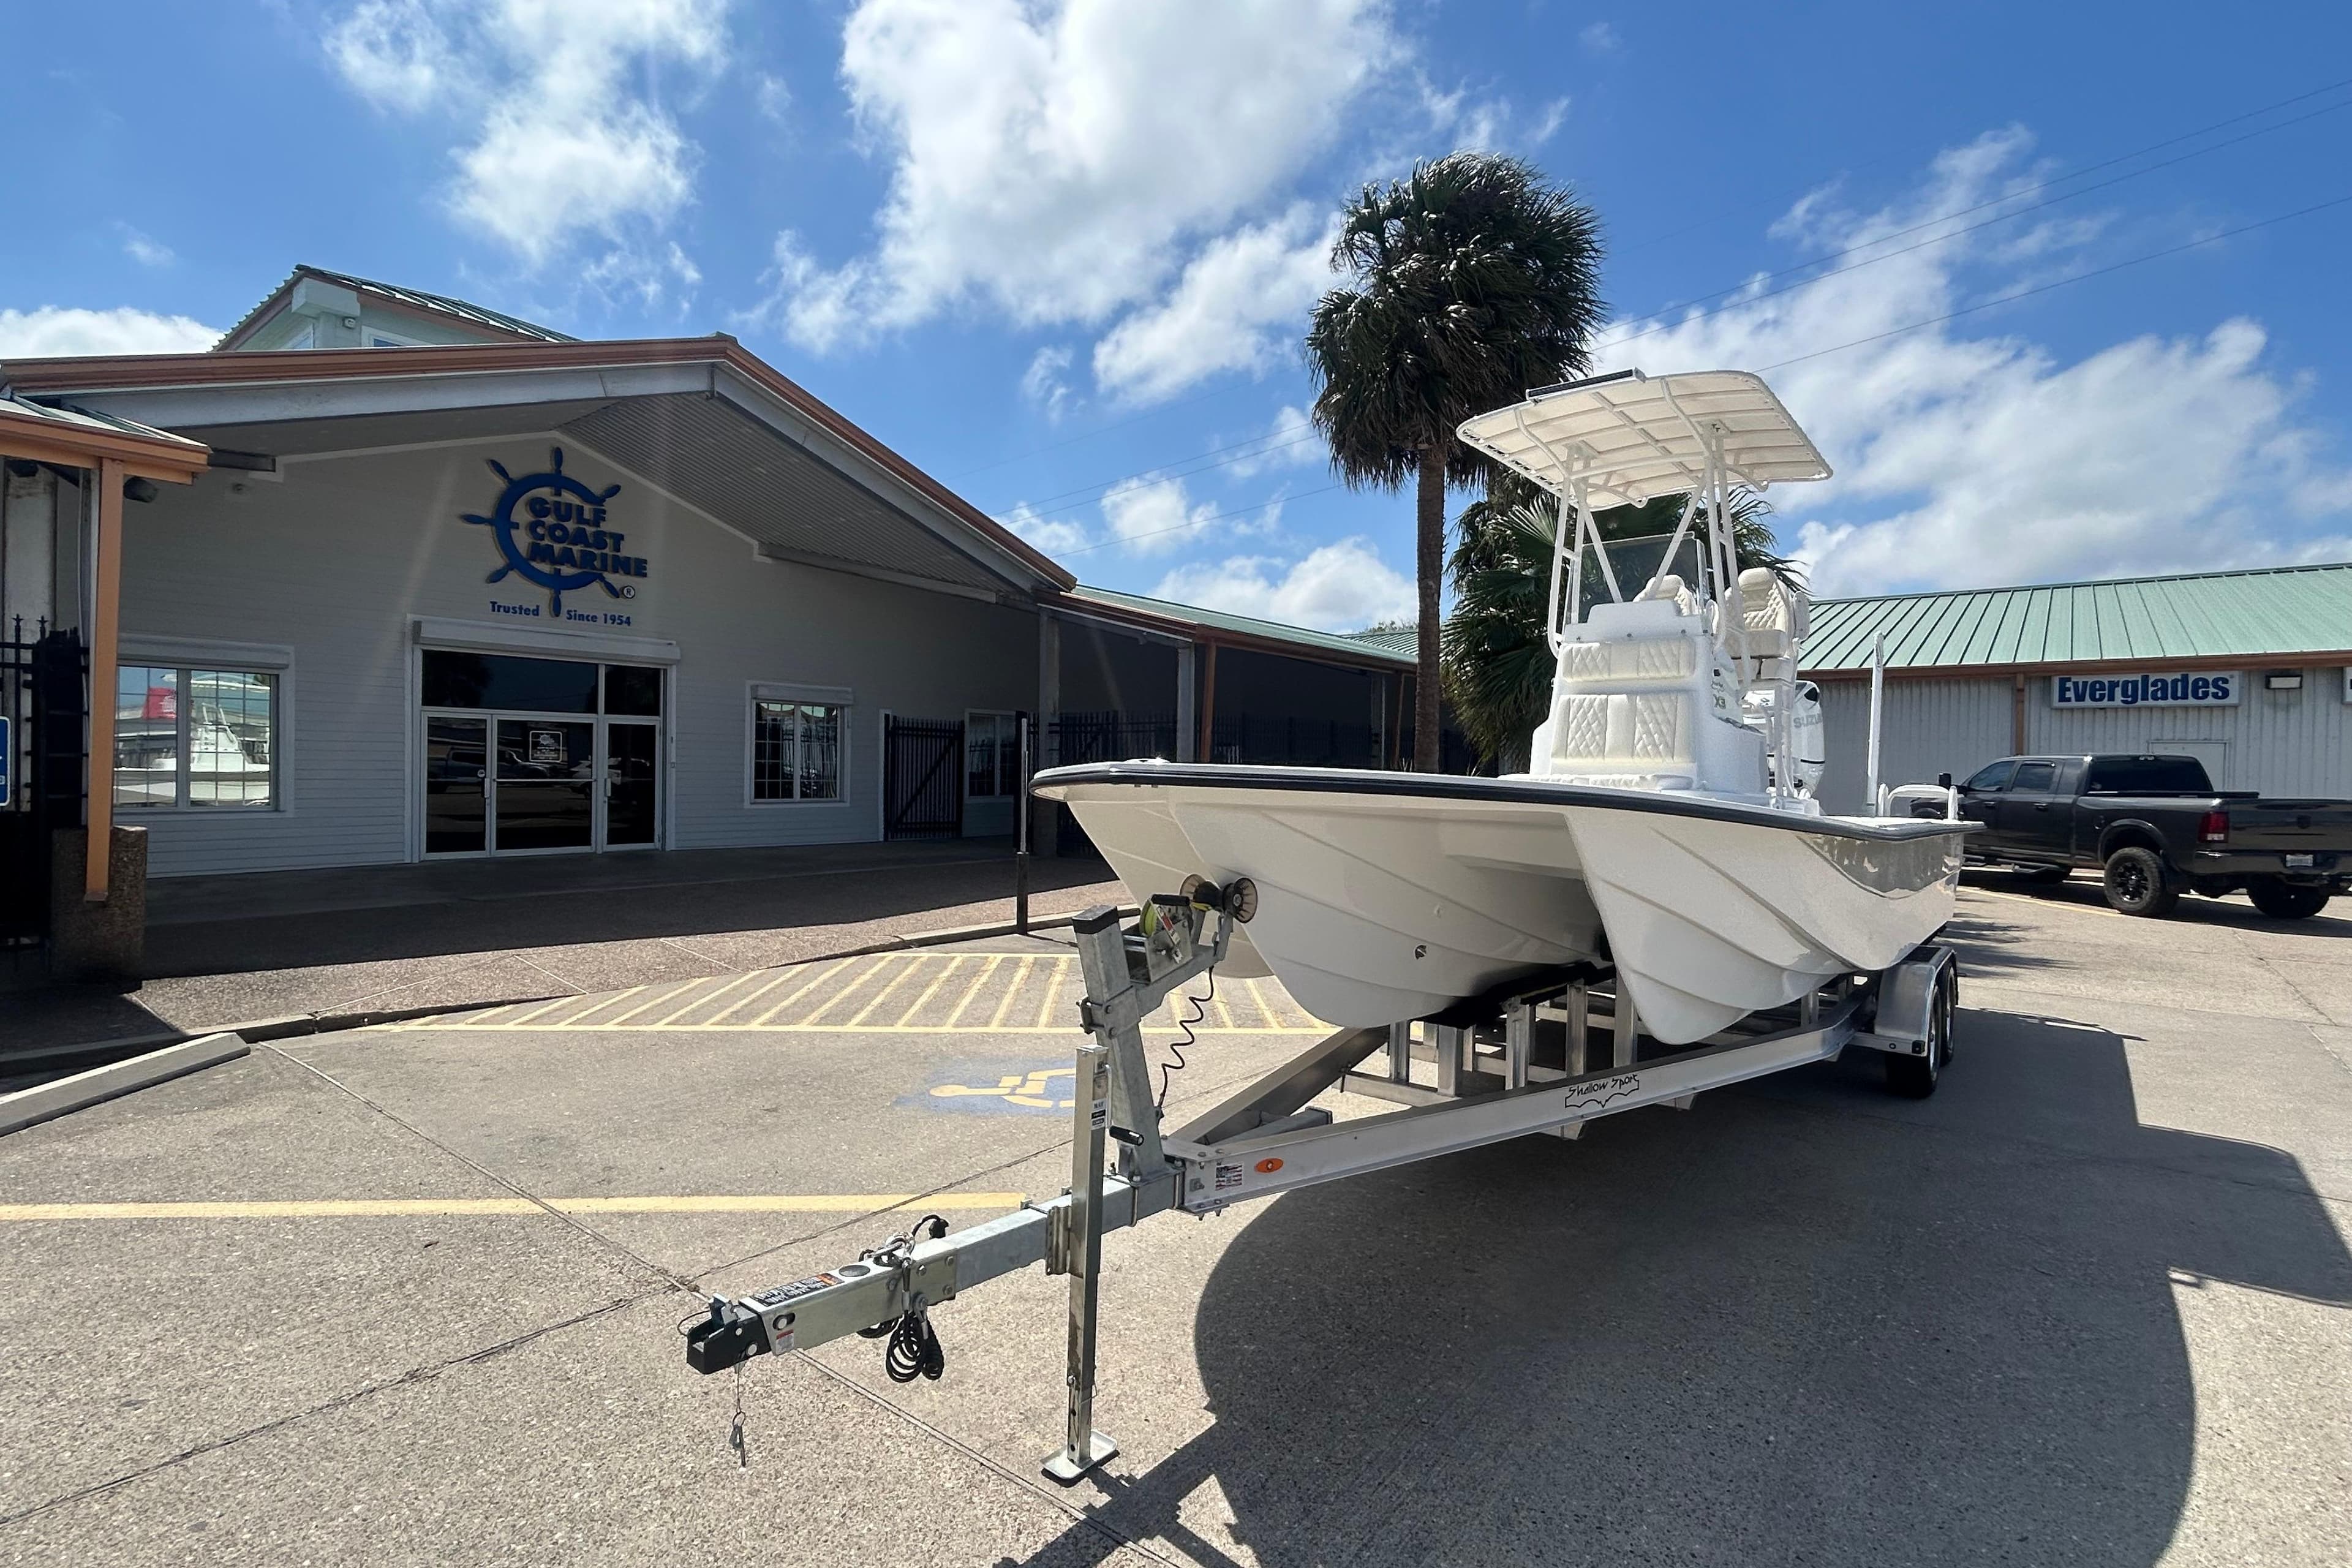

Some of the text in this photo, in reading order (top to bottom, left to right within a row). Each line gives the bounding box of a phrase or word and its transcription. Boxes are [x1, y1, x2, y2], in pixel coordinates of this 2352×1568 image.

[529, 497, 606, 527] GULF
[529, 519, 624, 552] COAST
[529, 542, 647, 578] MARINE
[490, 601, 540, 617] Trusted
[566, 609, 631, 627] Since 1954
[2058, 674, 2230, 704] Everglades
[1569, 1074, 1638, 1096] Shallow Sport
